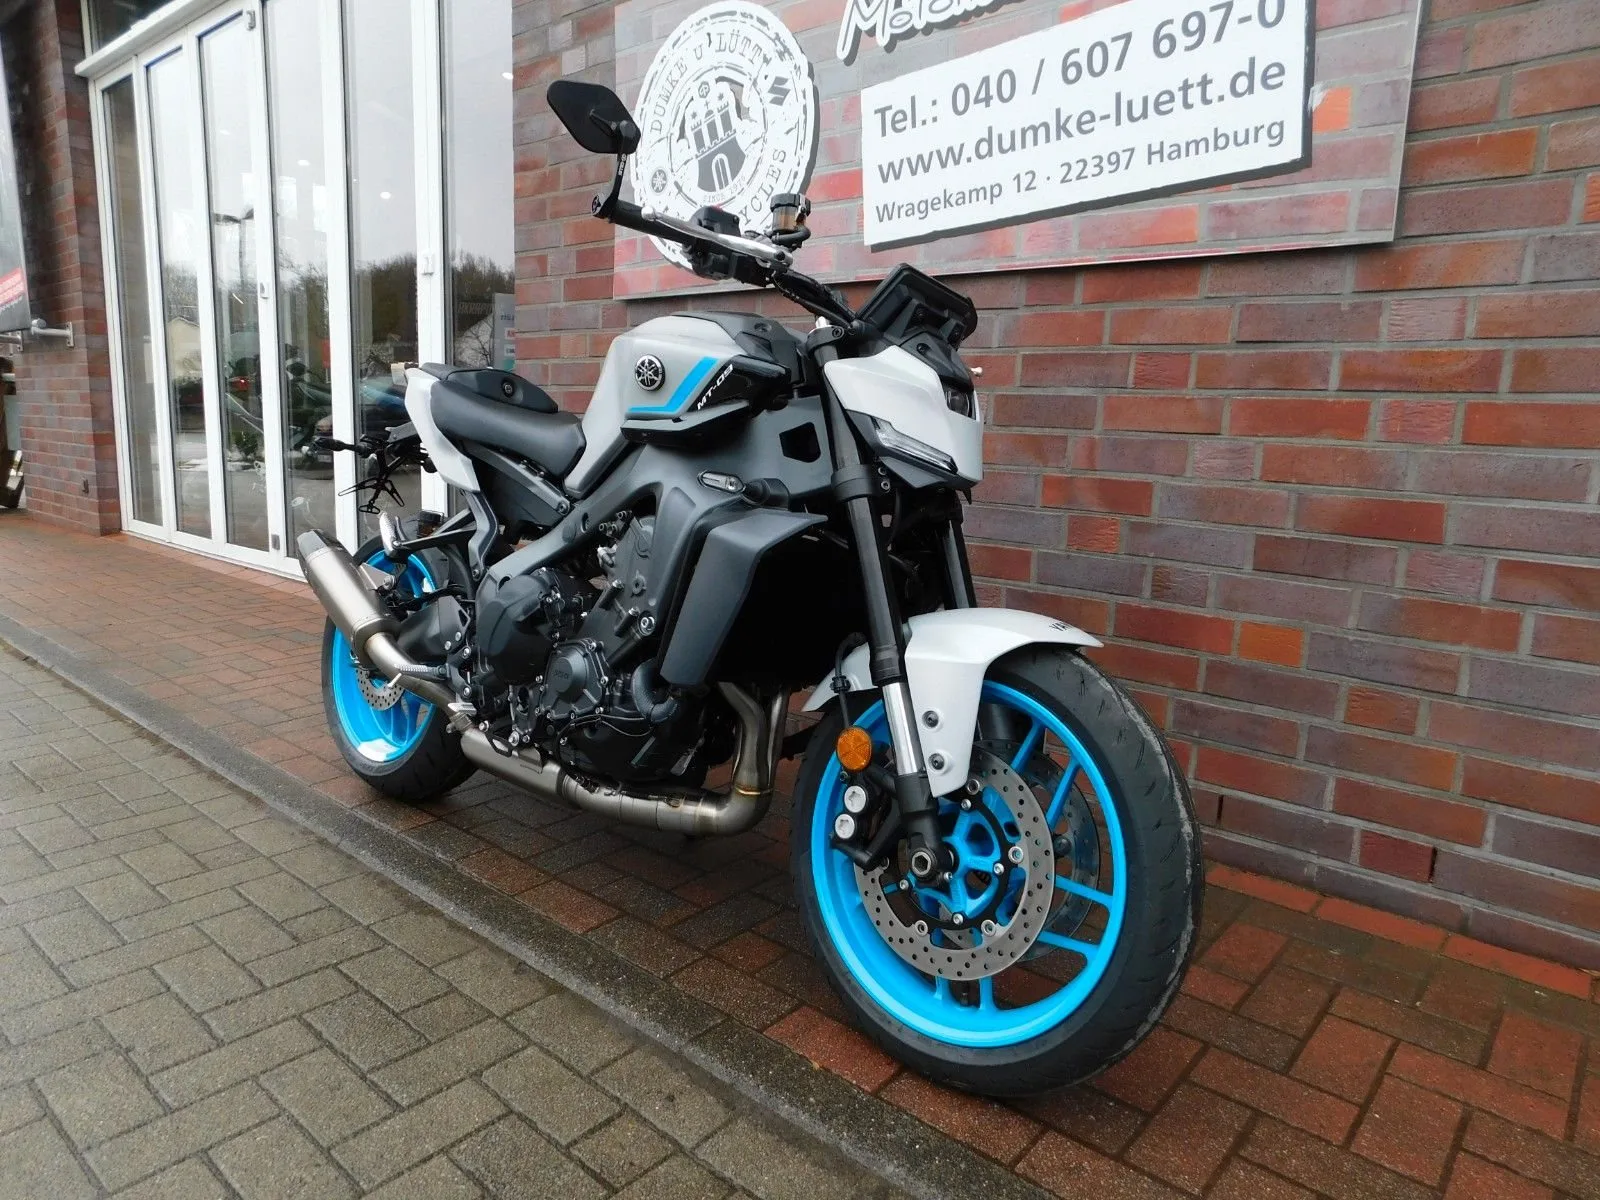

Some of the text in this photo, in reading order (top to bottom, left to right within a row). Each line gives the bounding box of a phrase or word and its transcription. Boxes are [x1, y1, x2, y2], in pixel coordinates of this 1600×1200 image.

[650, 57, 688, 135] DUMKE
[714, 29, 763, 66] LÜTT
[873, 0, 1286, 138] Tel.: 040 / 607 697-0
[877, 55, 1286, 184] www.dumke-luett.de
[875, 183, 1003, 223] Wragekamp
[1012, 169, 1037, 194] 12
[1059, 147, 1136, 185] 22397
[1147, 119, 1285, 166] Hamburg
[697, 364, 734, 411] MT-09
